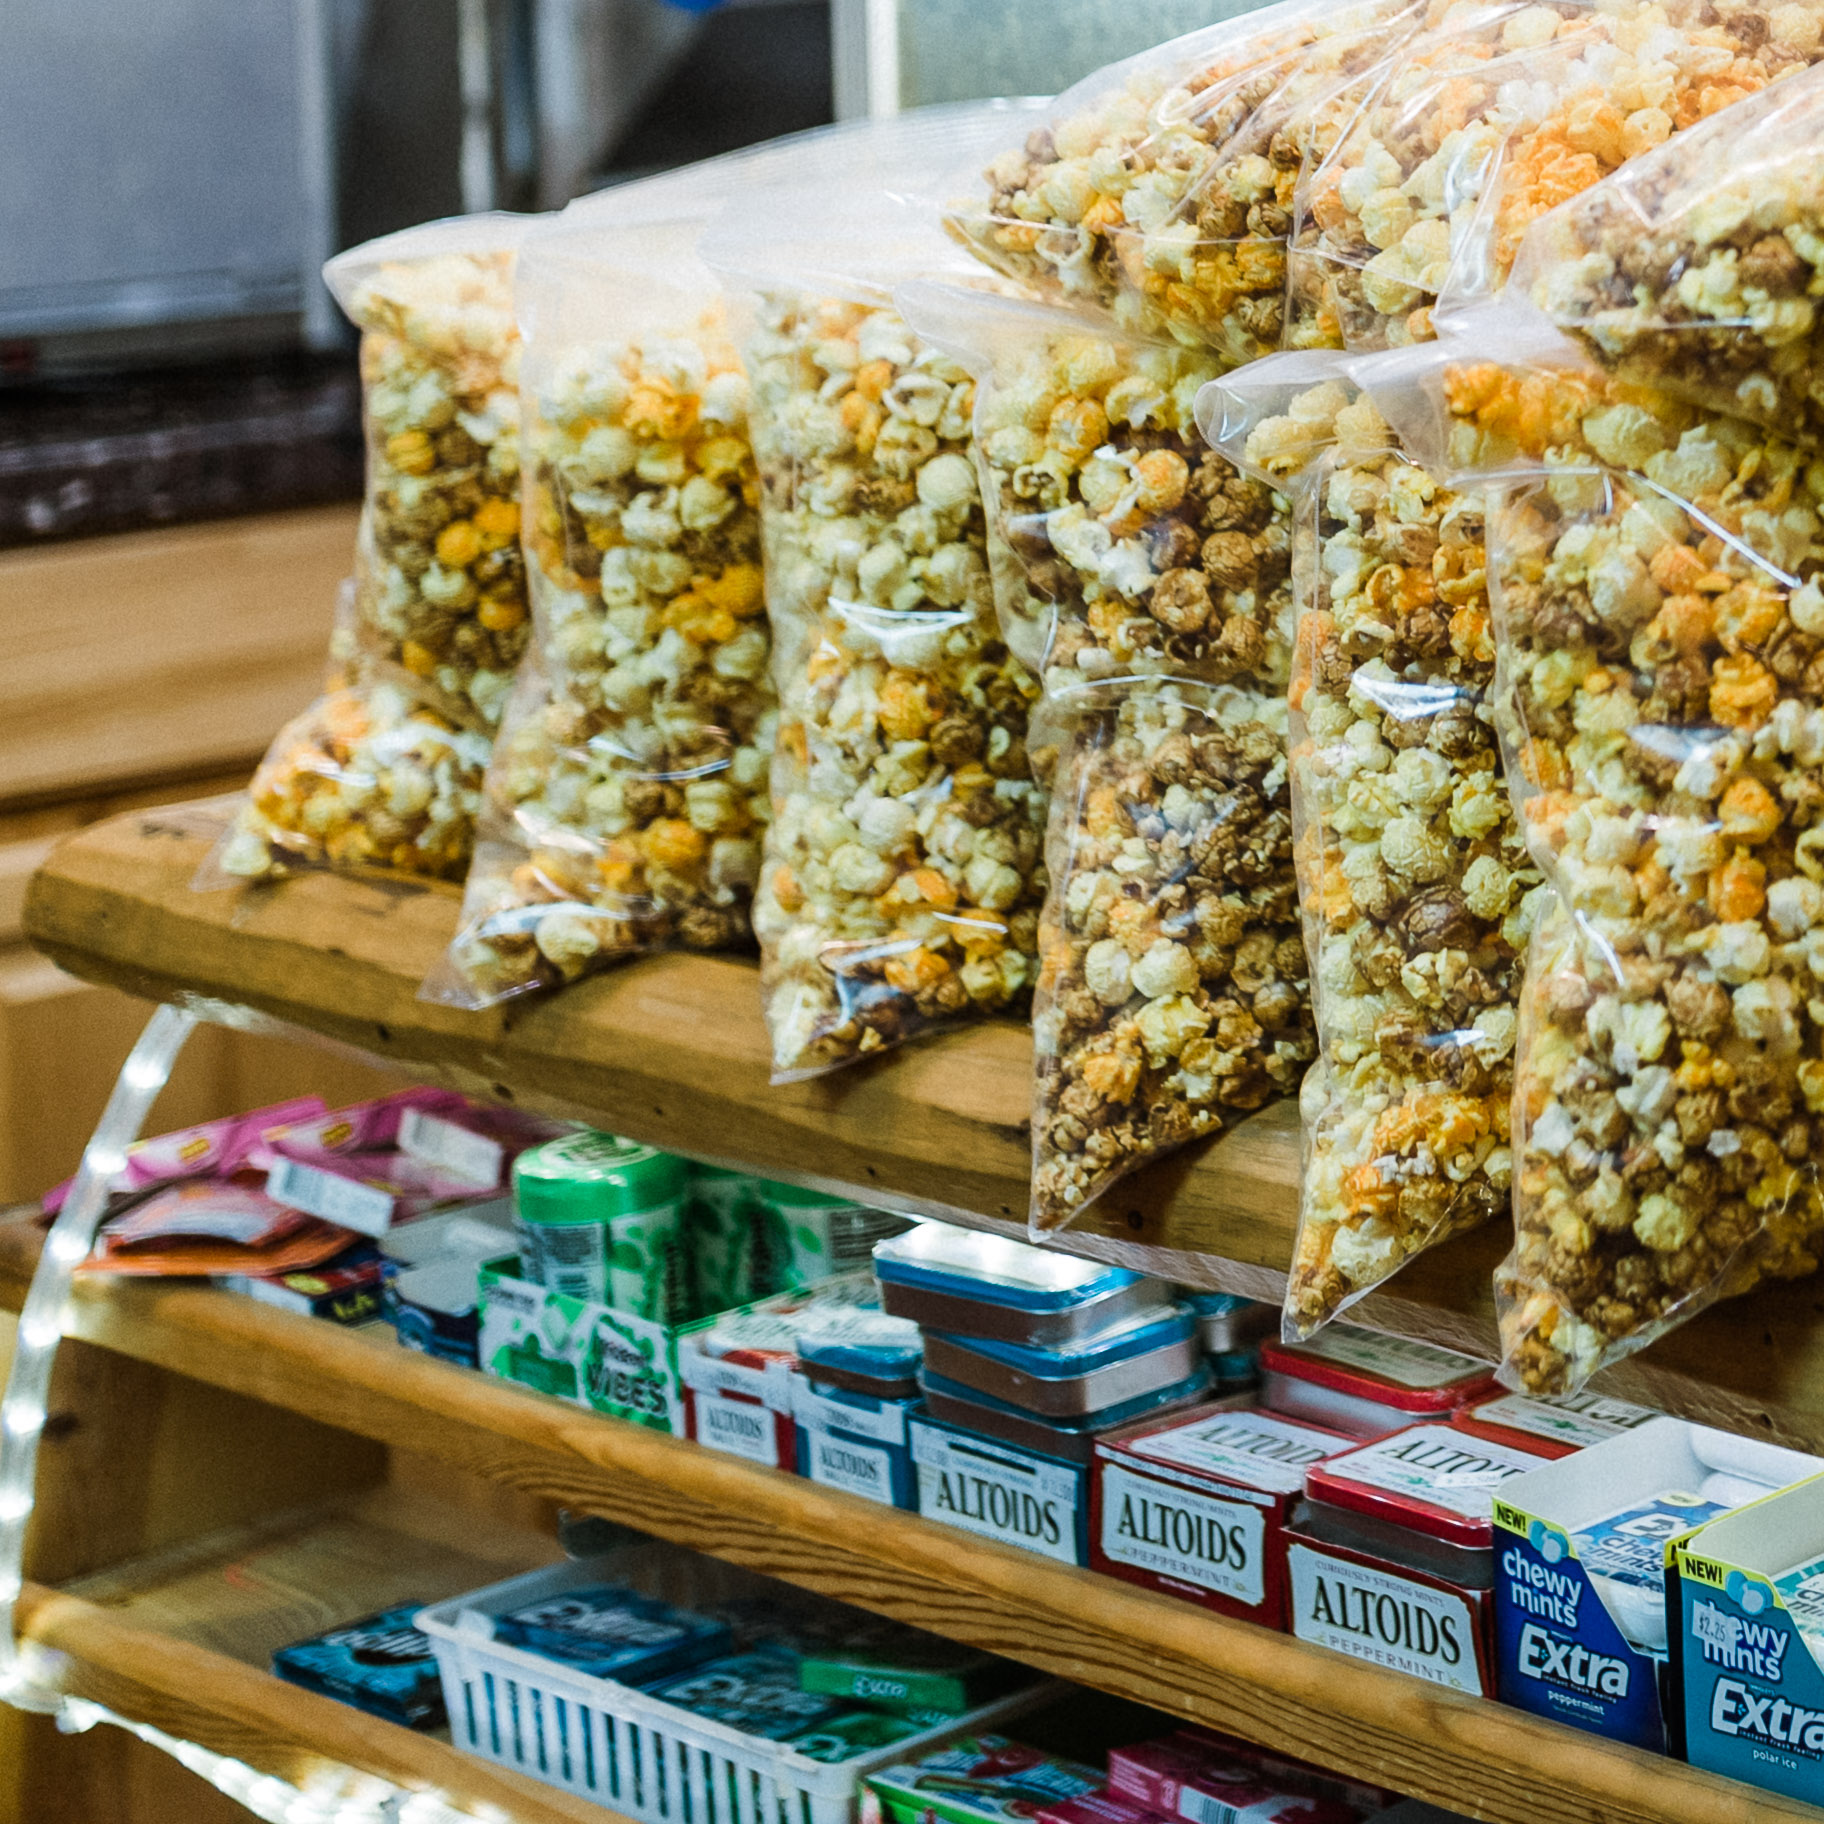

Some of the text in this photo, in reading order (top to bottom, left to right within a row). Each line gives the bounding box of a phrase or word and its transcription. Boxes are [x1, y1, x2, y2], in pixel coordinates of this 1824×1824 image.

[707, 1406, 764, 1440] ALTOIDS
[820, 1445, 878, 1481] ALTOIDS
[1192, 1424, 1328, 1465] ALTOID
[935, 1470, 1061, 1546] ALTOIDS
[1496, 1503, 1527, 1533] NEW!
[1117, 1493, 1248, 1572] ALTOIDS
[1128, 1547, 1231, 1588] PEPPERMINT
[1502, 1546, 1582, 1608] chewy
[1685, 1557, 1723, 1585] NEW!
[1311, 1575, 1462, 1666] ALTOIDS
[1510, 1580, 1578, 1629] mints
[1328, 1634, 1446, 1683] PEPPERMINT
[1518, 1622, 1630, 1698] Extra
[1547, 1690, 1606, 1716] peppermint
[1752, 1748, 1798, 1771] polar ice
